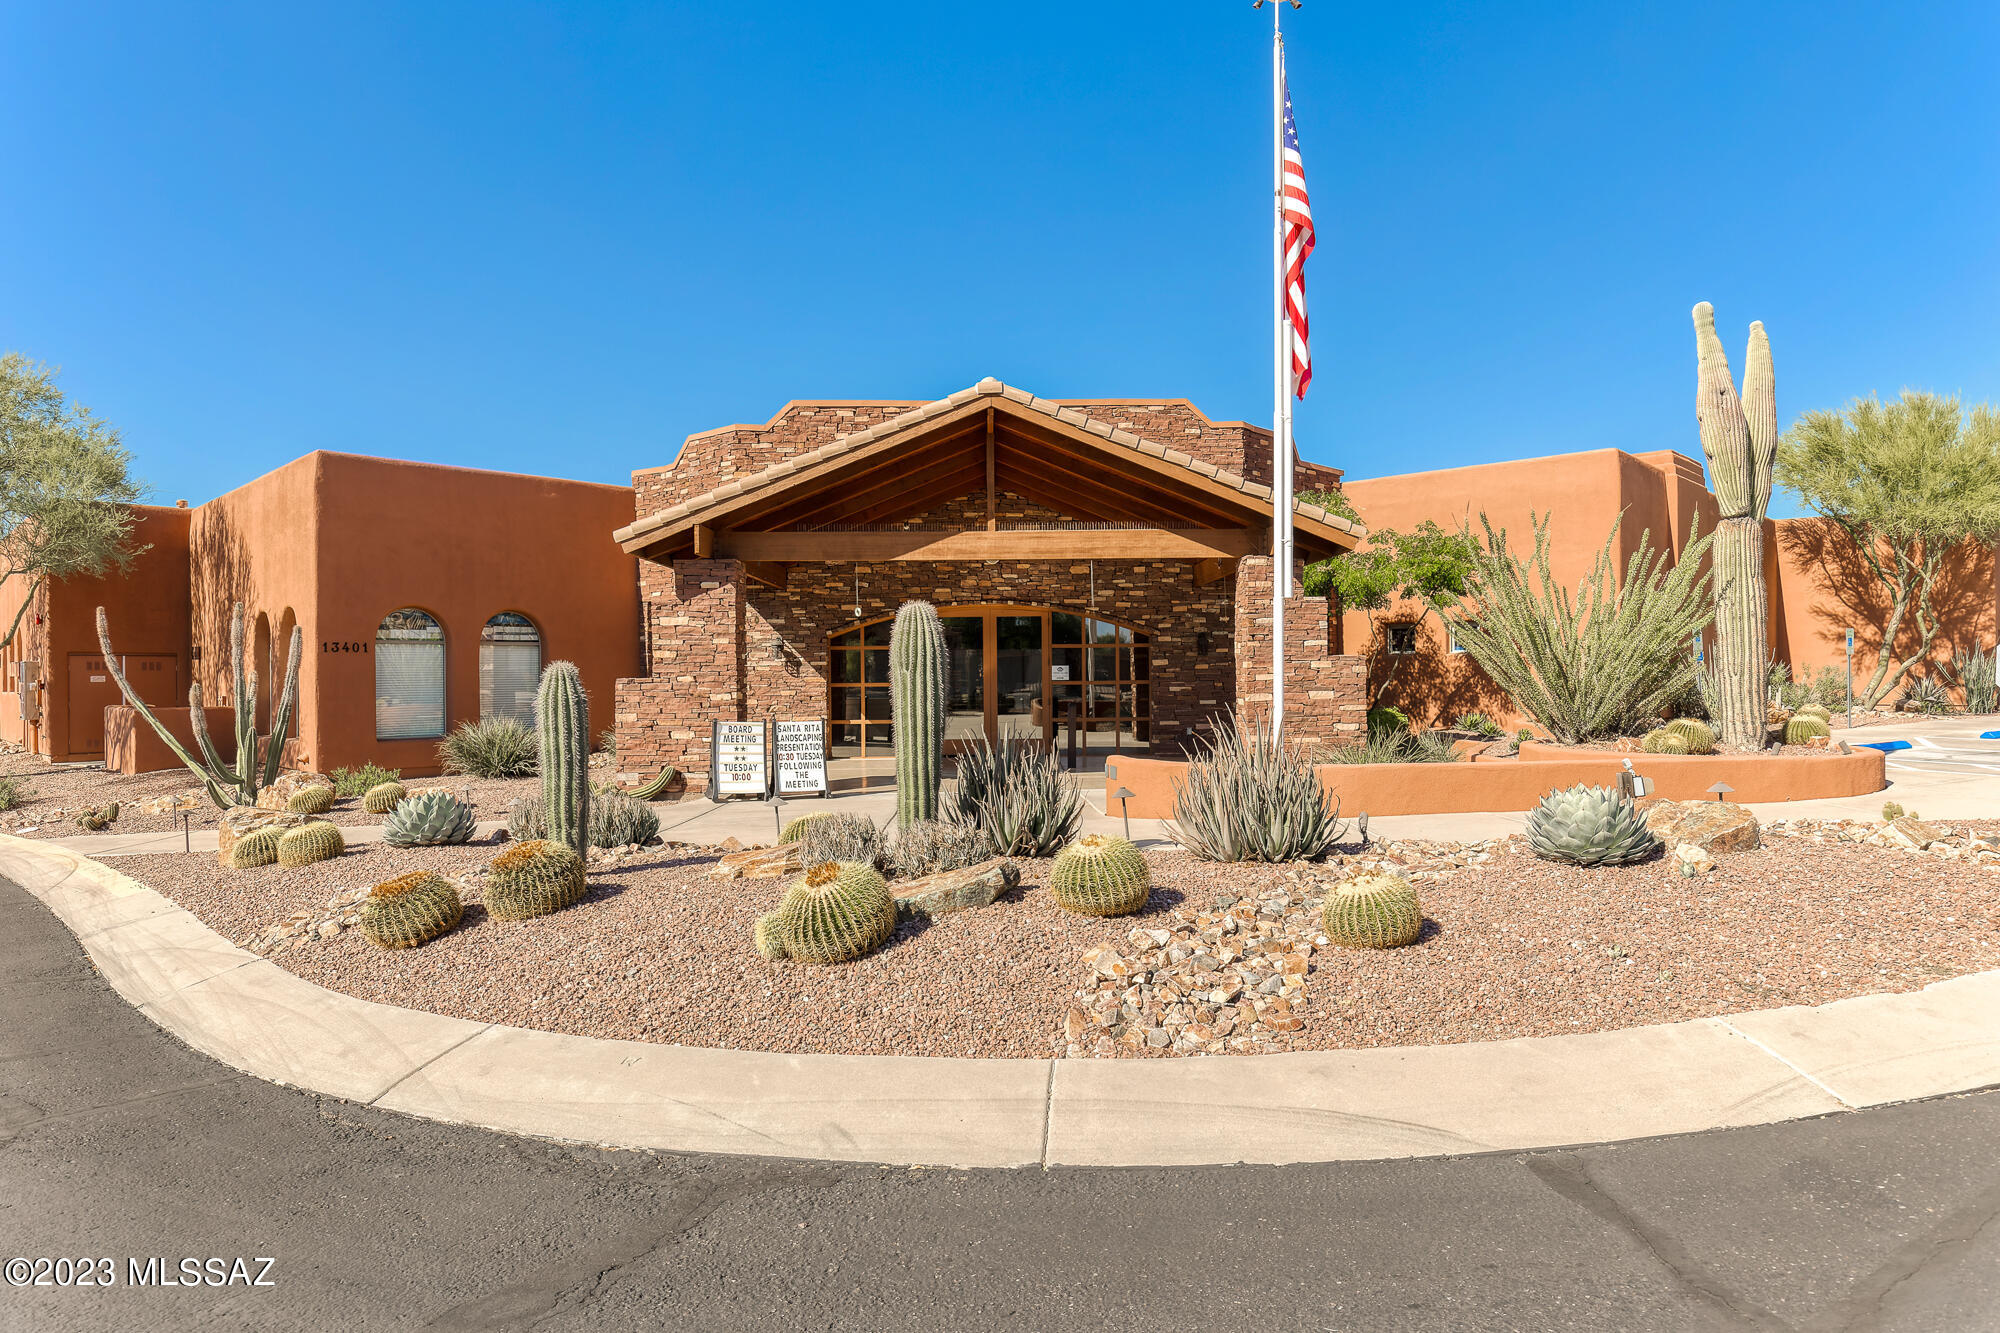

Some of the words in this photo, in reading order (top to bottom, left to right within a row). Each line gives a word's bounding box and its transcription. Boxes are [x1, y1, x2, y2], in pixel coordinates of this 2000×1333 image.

[323, 642, 368, 653] 13401
[728, 725, 753, 734] BOARD
[777, 724, 801, 732] SANTA
[804, 724, 820, 732] RITA
[723, 735, 757, 743] MEETING
[776, 733, 823, 742] LANDSCAPING
[776, 743, 823, 751] PRESENTATION
[776, 752, 795, 760] 10:30
[796, 752, 824, 760] TUESDAY
[724, 763, 758, 772] TUESDAY
[779, 761, 823, 770] FOLLOWING
[732, 773, 752, 781] 10:00
[795, 771, 809, 779] THE
[785, 780, 819, 788] MEETING
